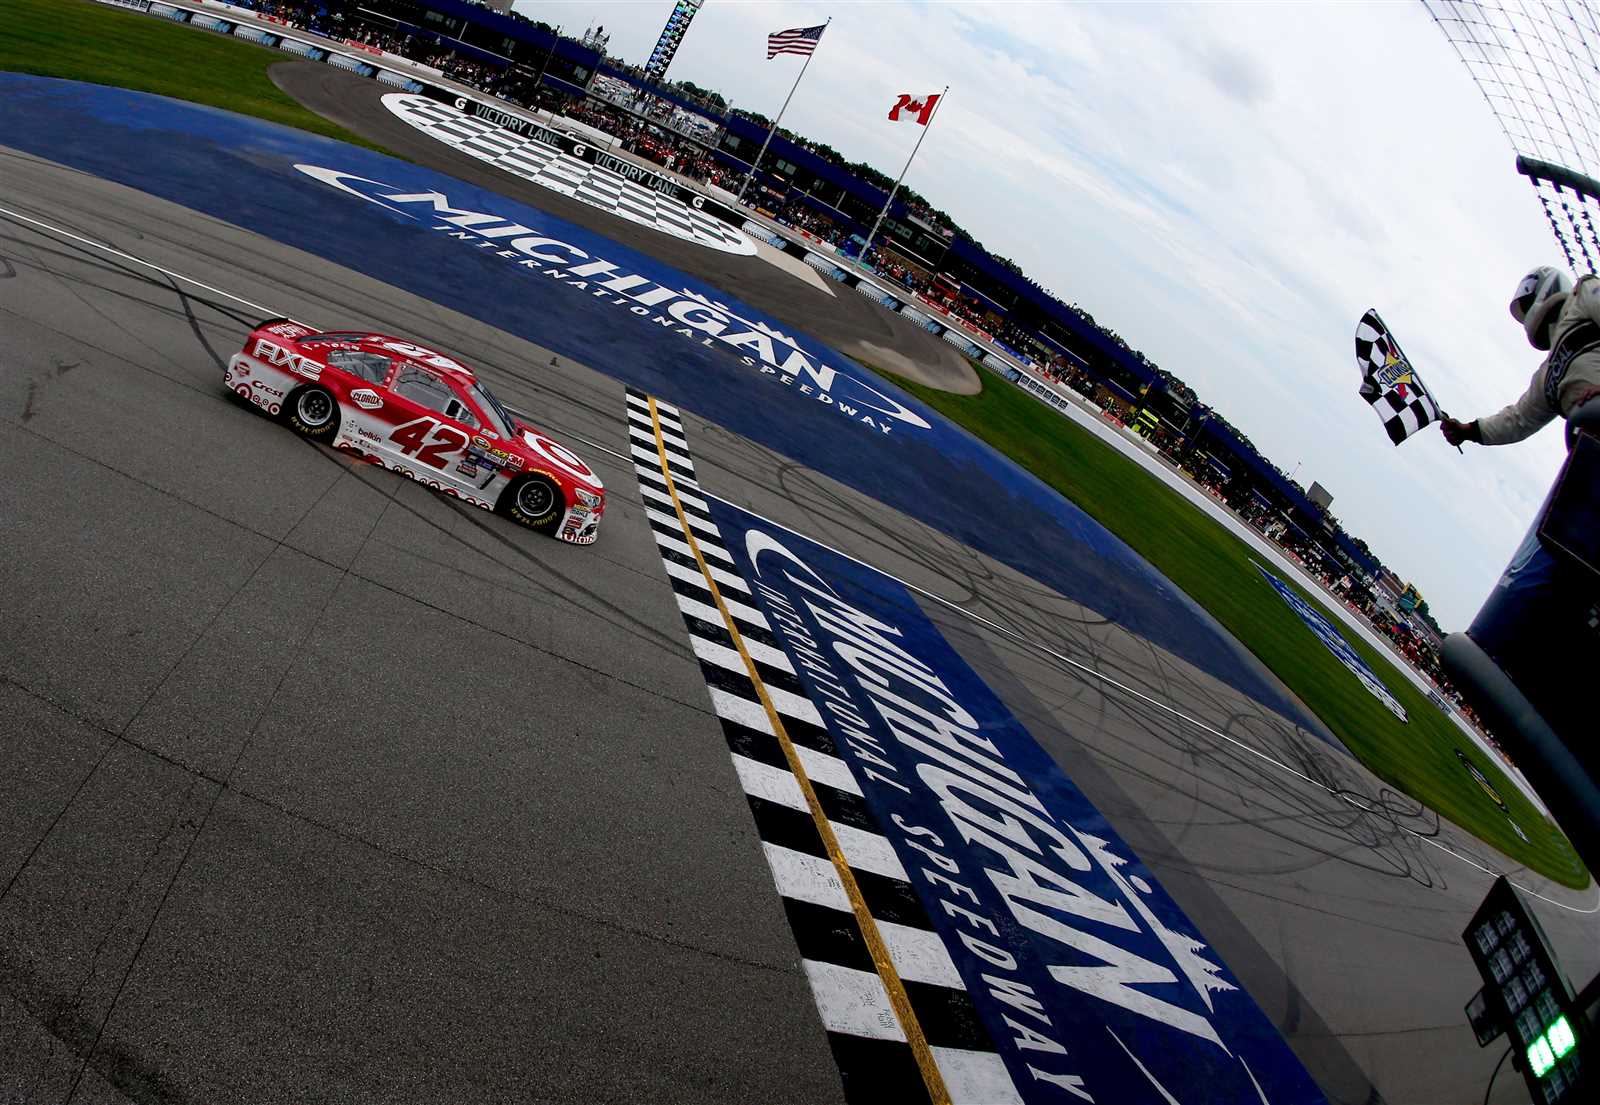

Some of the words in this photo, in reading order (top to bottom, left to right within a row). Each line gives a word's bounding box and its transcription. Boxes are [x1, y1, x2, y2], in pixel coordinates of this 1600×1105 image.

[475, 103, 528, 135] VICTORY
[527, 123, 562, 148] LANE
[593, 151, 648, 182] VICTORY
[647, 174, 681, 199] LANE
[376, 189, 837, 394] MICHIGAN
[432, 225, 717, 351] INTERNATIONAL
[740, 355, 893, 435] SPEEDWAY
[252, 338, 326, 381] AXE
[252, 379, 284, 398] Crest
[353, 392, 382, 404] CLOROX
[358, 428, 382, 443] belkin
[389, 419, 467, 470] 42
[508, 454, 524, 466] 3M
[781, 568, 1233, 1058] MICHIGAN
[752, 579, 912, 795] INTERNATIONAL
[890, 812, 1096, 1105] SPEEDWAY
